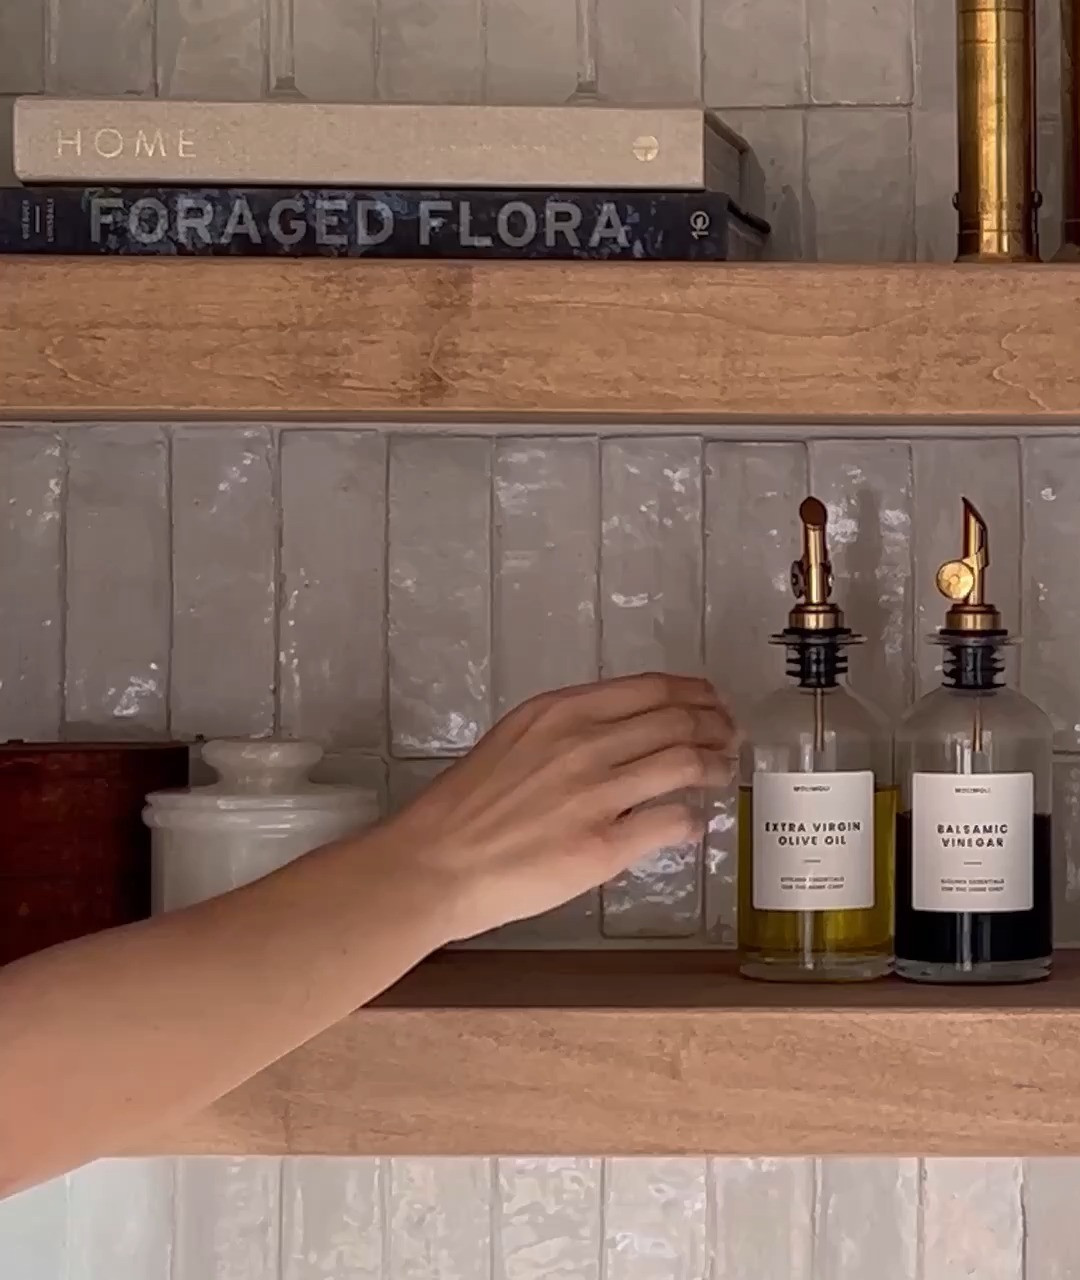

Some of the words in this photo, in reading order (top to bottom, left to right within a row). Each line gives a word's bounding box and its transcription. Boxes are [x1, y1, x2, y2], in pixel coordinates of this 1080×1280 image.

[56, 128, 197, 158] HOME
[90, 196, 395, 246] FORAGED
[419, 200, 631, 248] FLORA
[765, 821, 806, 833] EXTRA
[812, 821, 861, 833] VIRGIN
[937, 824, 1009, 835] BALSAMIC
[778, 835, 818, 846] OLIVE
[824, 835, 847, 846] OIL
[941, 837, 1004, 848] VINEGAR
